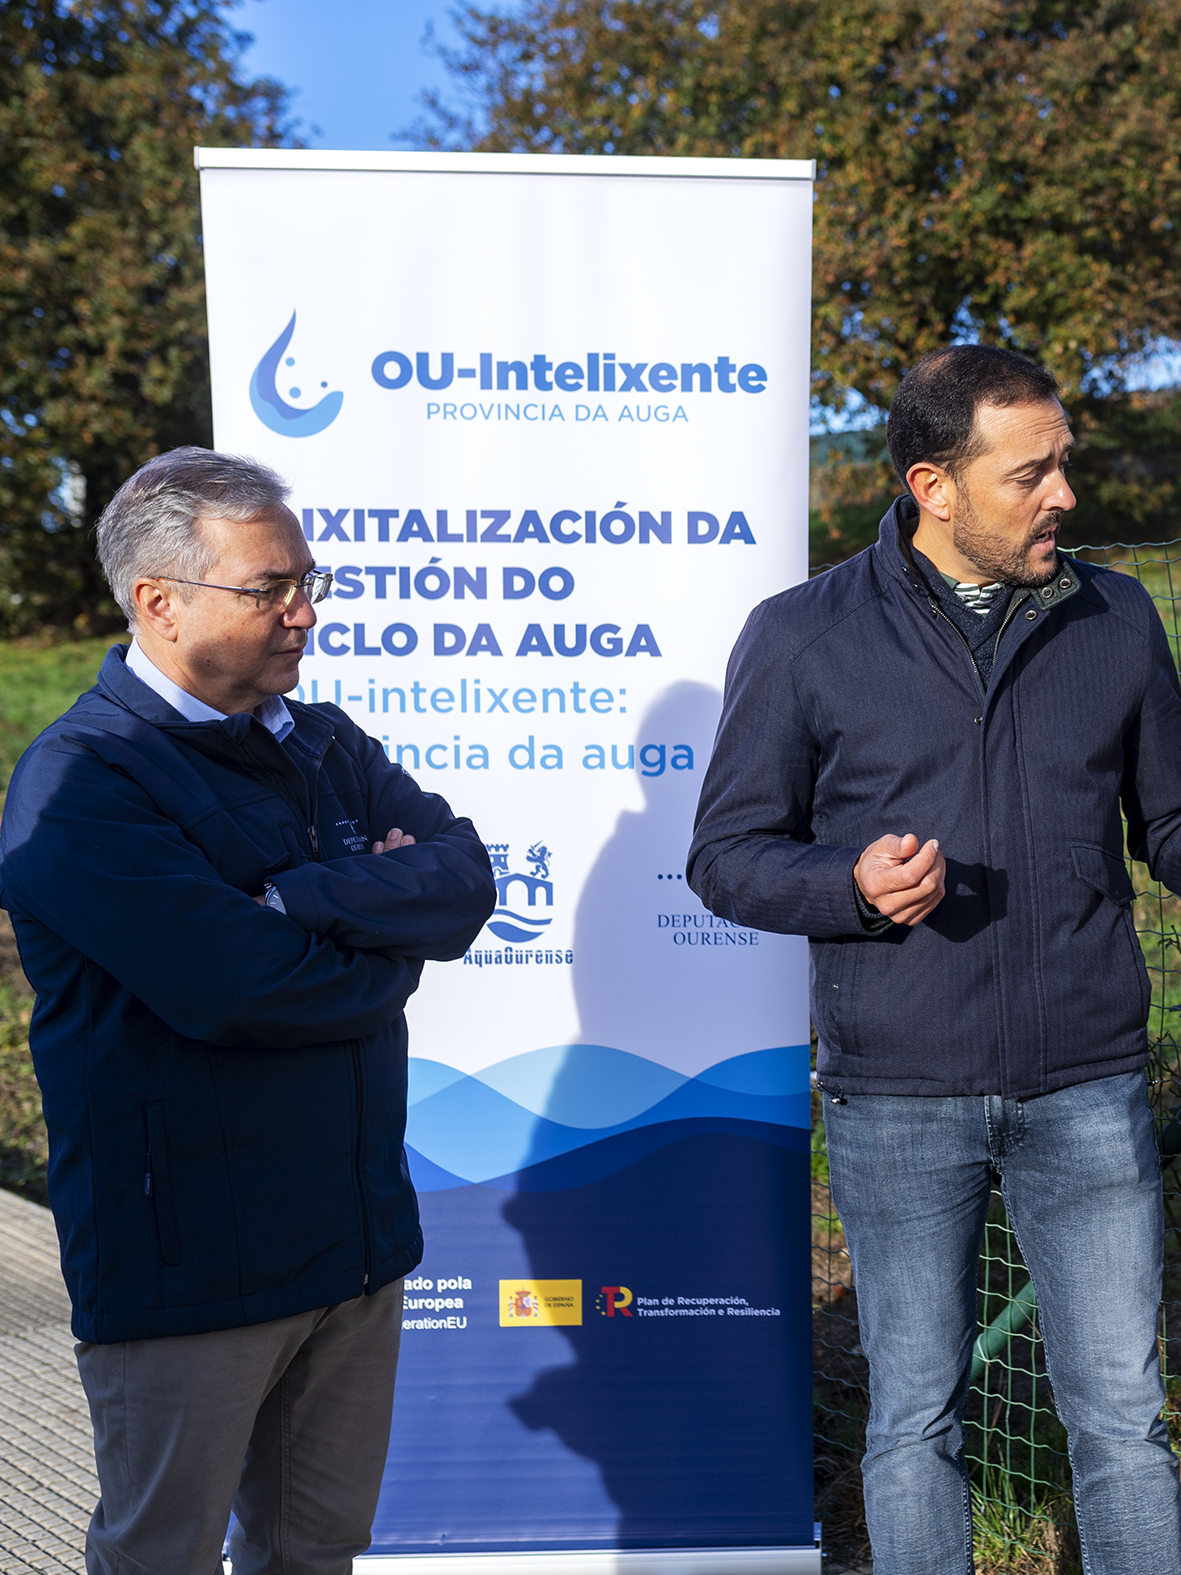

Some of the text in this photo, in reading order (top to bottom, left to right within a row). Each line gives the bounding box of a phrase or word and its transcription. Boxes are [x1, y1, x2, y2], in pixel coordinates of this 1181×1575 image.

[371, 350, 769, 394] OU-Intelixente
[426, 402, 689, 423] PROVINCIA DA AUGA
[302, 501, 757, 545] IXITALIZACIÓN DA
[502, 566, 576, 601] DO
[303, 622, 663, 658] ICLO DA AUGA
[297, 678, 628, 715] U-intelixente:
[383, 735, 696, 778] incia da auga
[657, 914, 742, 929] DEPUTA
[673, 931, 760, 947] OURENSE
[463, 946, 574, 968] AquaOurense
[437, 1275, 473, 1293] pola
[553, 1301, 575, 1309] ESPAÑA
[636, 1295, 749, 1307] Plan de Recuperación,
[636, 1306, 781, 1317] Transformación e Resiliencia
[402, 1315, 468, 1330] erationEU
